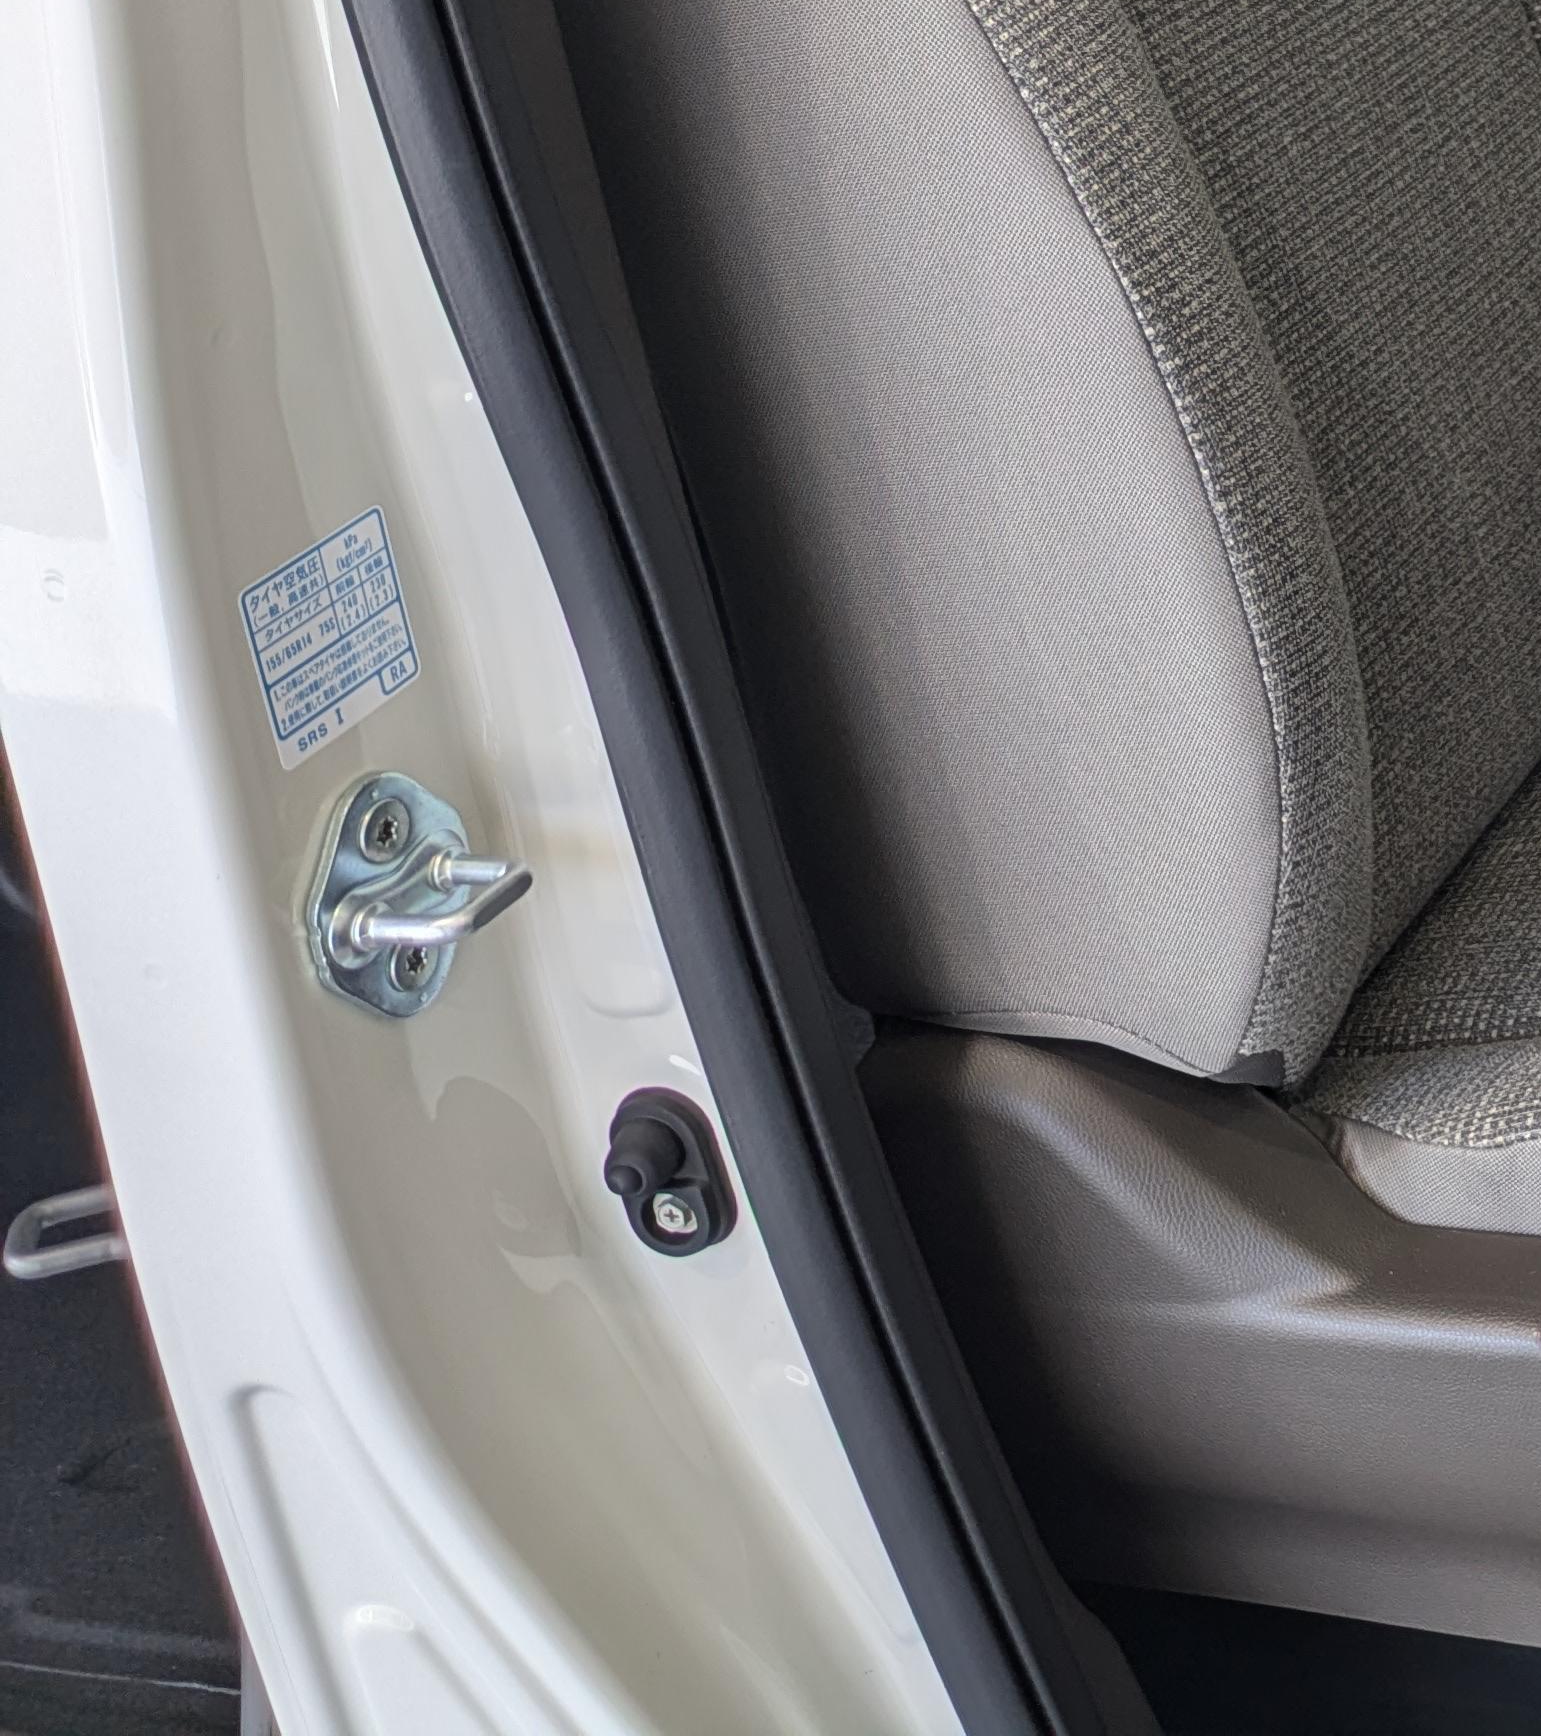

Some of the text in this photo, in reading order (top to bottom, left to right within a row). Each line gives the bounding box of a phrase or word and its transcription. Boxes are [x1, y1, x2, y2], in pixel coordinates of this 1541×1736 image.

[250, 555, 321, 614] タイヤ空気圧
[370, 573, 386, 593] 230
[342, 593, 358, 614] 240
[266, 616, 336, 673] 155/65R14 75S
[390, 660, 408, 683] RA
[297, 722, 328, 751] SRS
